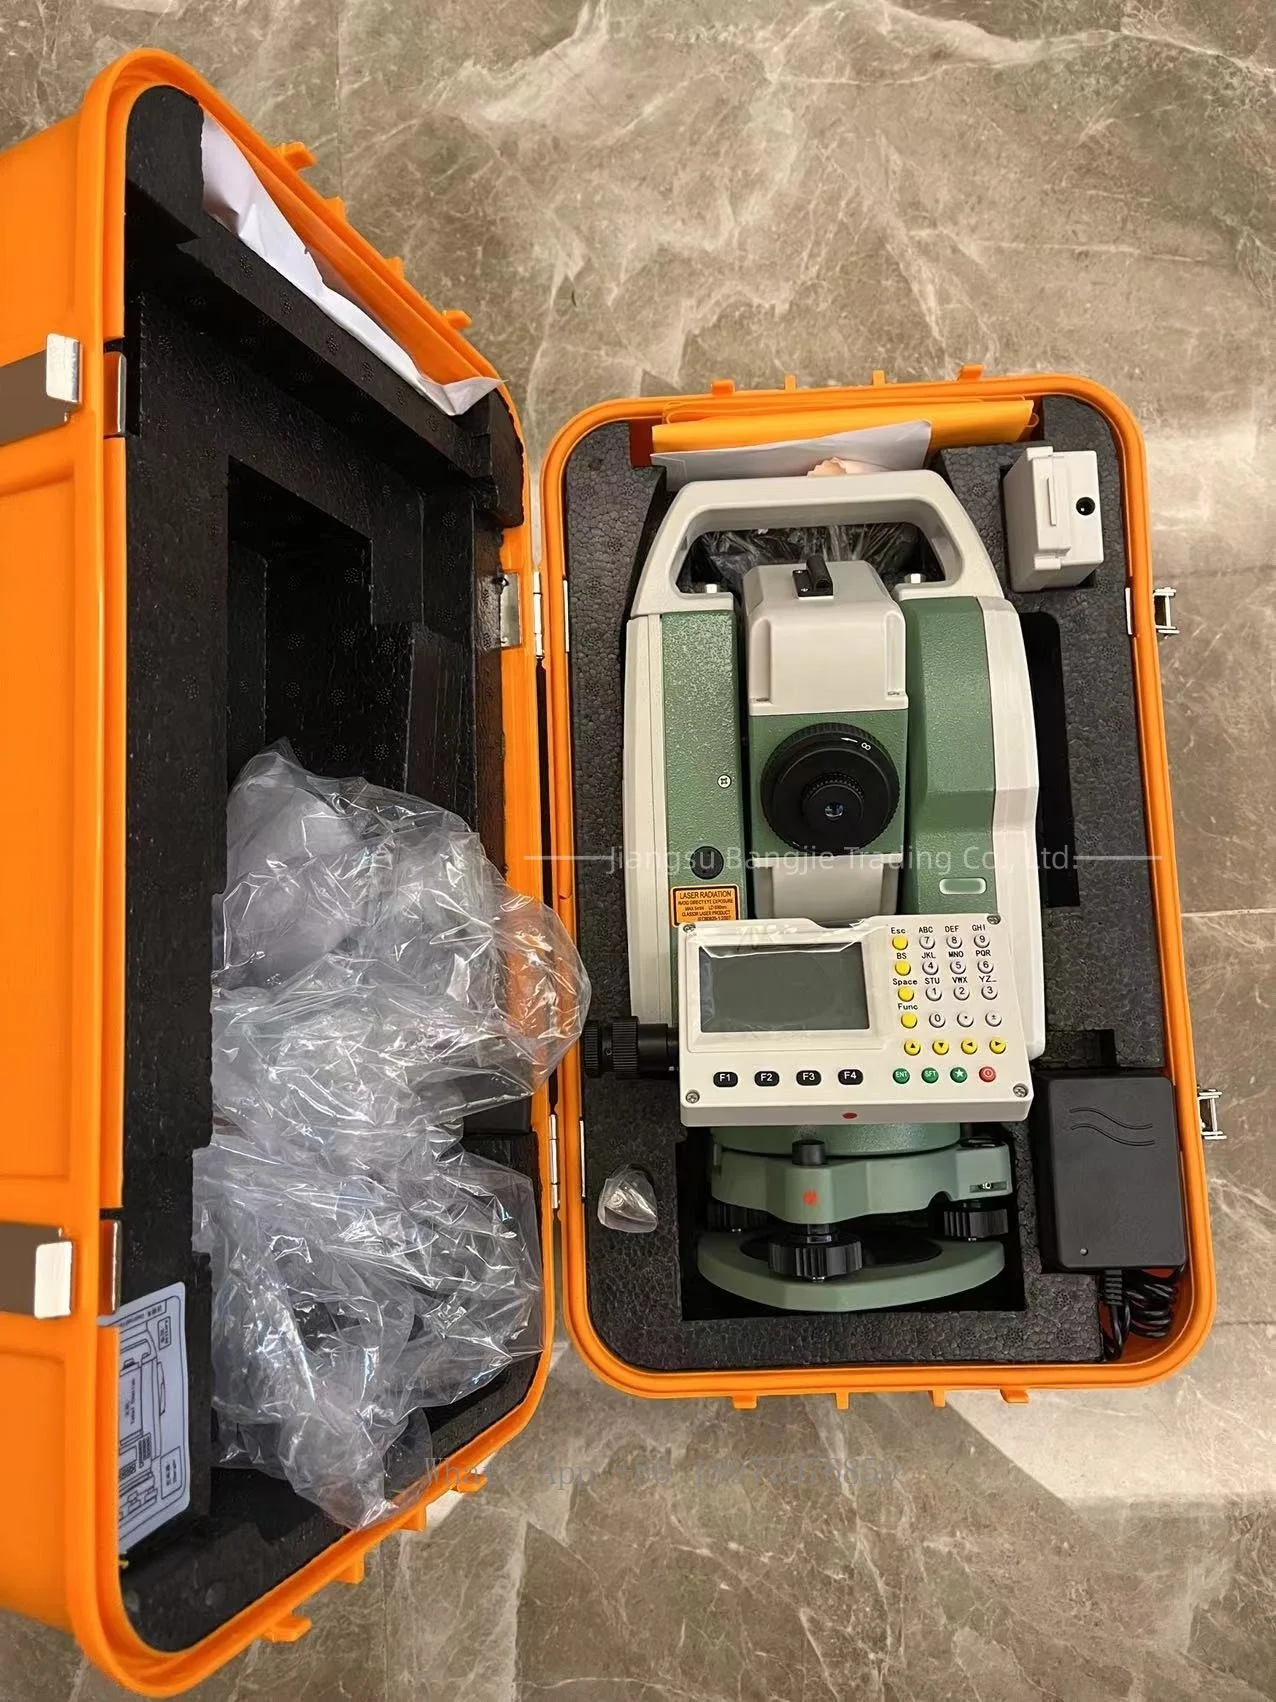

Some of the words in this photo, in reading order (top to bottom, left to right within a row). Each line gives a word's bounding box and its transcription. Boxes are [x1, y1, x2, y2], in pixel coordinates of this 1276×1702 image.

[988, 986, 993, 994] 3
[719, 1074, 731, 1082] F1
[760, 1073, 773, 1082] F2
[802, 1072, 815, 1080] F3
